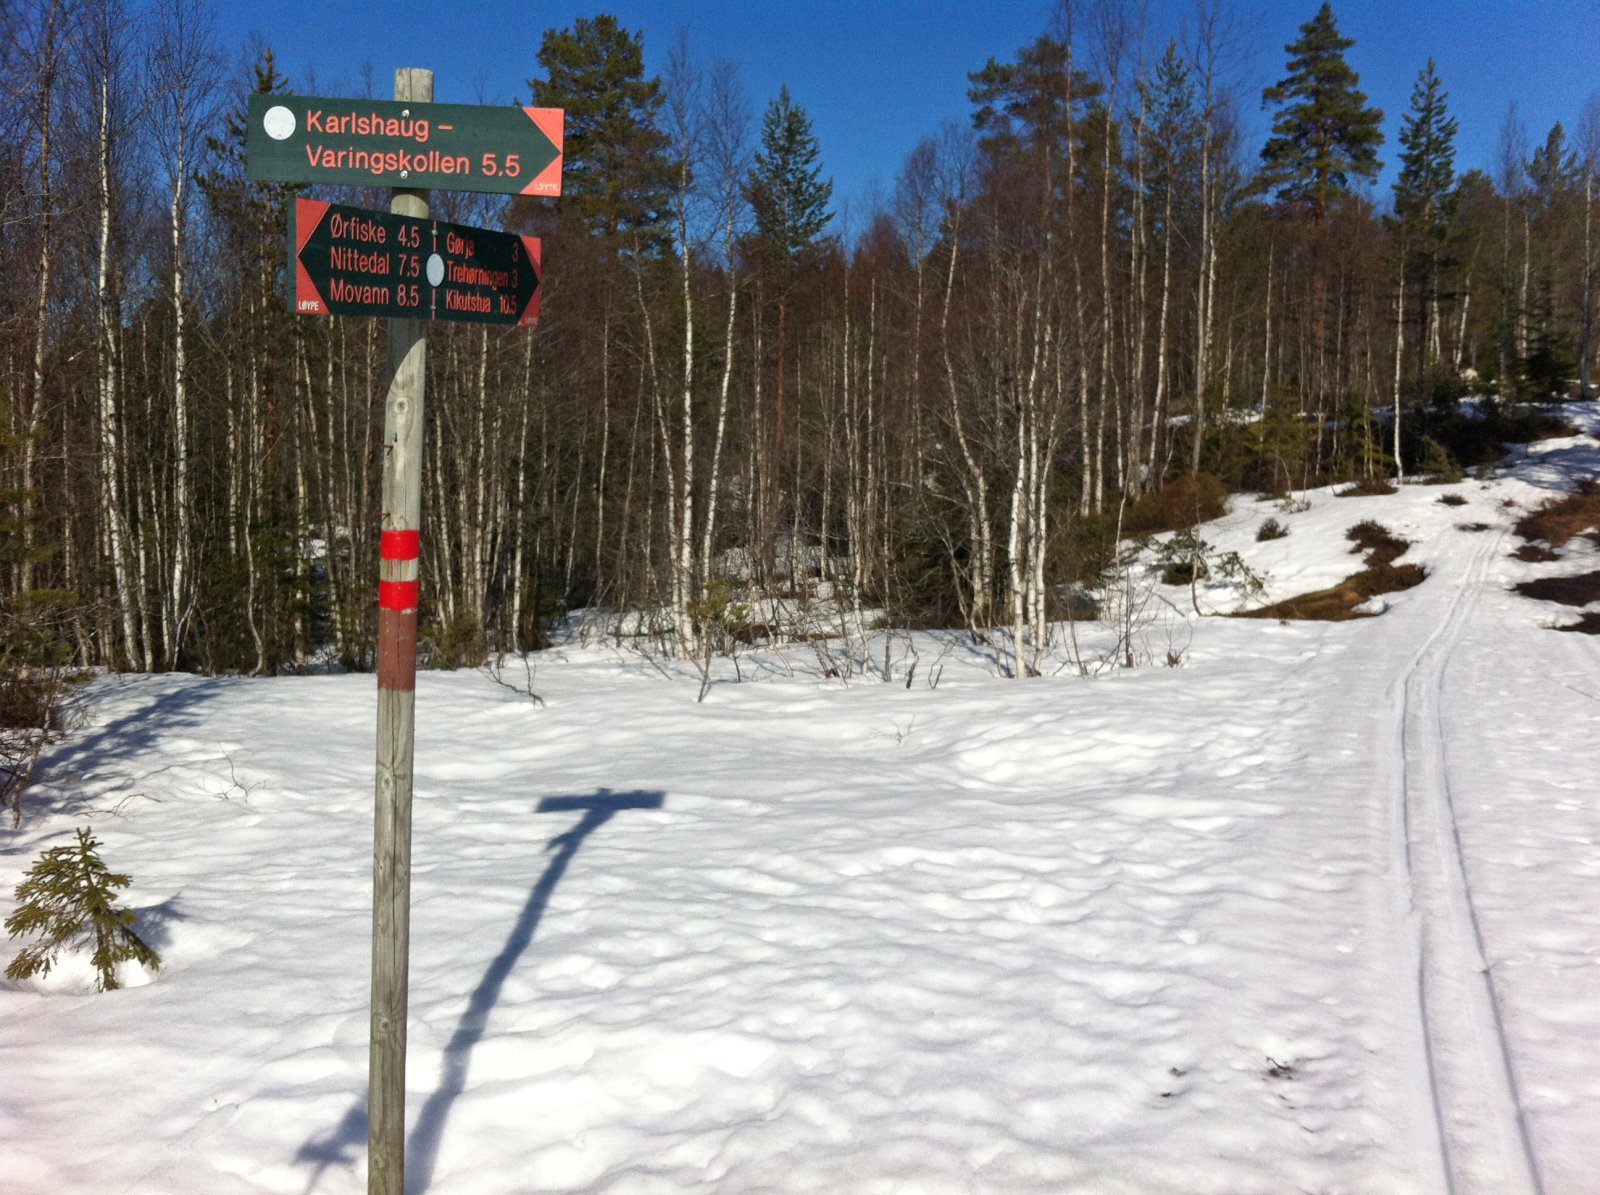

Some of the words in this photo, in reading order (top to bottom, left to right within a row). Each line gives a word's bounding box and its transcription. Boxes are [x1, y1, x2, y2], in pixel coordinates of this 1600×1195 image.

[306, 109, 430, 142] Karlshaug
[305, 144, 470, 175] Varingskollen
[330, 213, 386, 244] Ørfiske
[330, 245, 390, 275] Nittedal
[298, 300, 319, 311] LØYPE
[330, 277, 389, 305] Movann
[445, 288, 491, 313] Kikutstua
